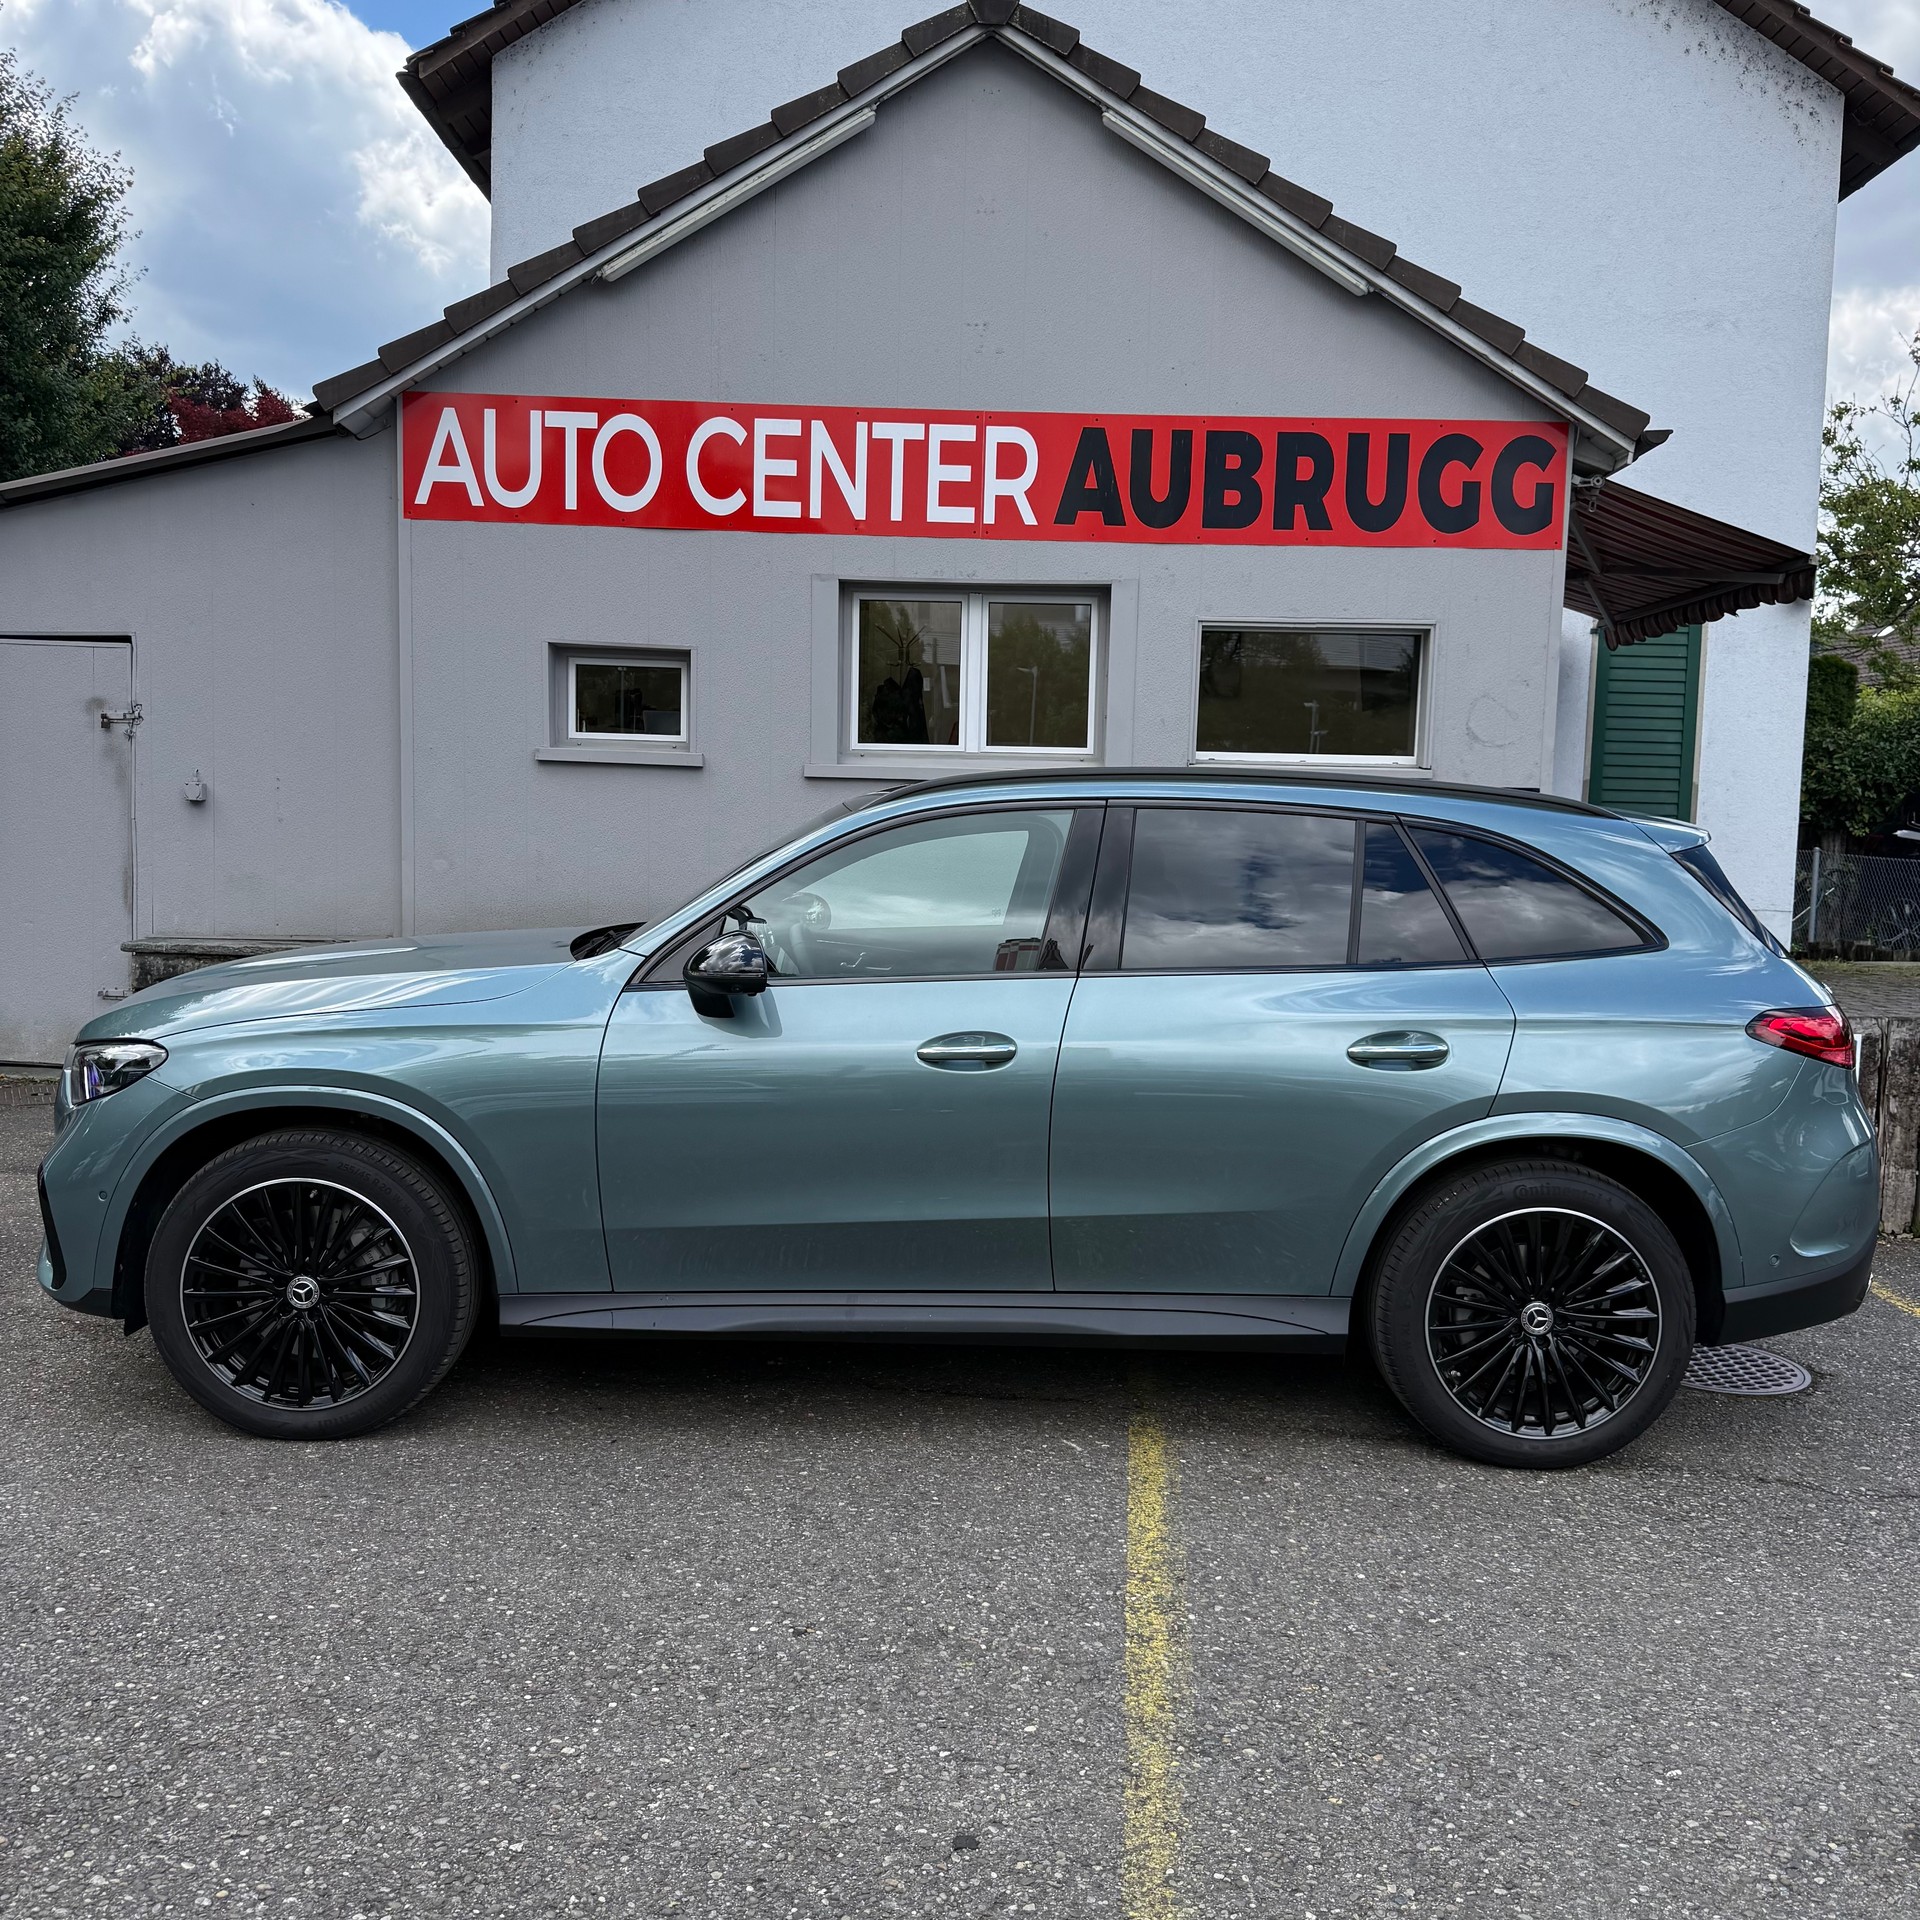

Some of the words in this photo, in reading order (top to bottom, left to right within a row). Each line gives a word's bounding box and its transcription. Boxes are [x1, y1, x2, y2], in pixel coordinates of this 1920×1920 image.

[414, 407, 663, 513] AUTO
[686, 416, 1039, 526] CENTER
[1055, 428, 1556, 536] AUBRUGG
